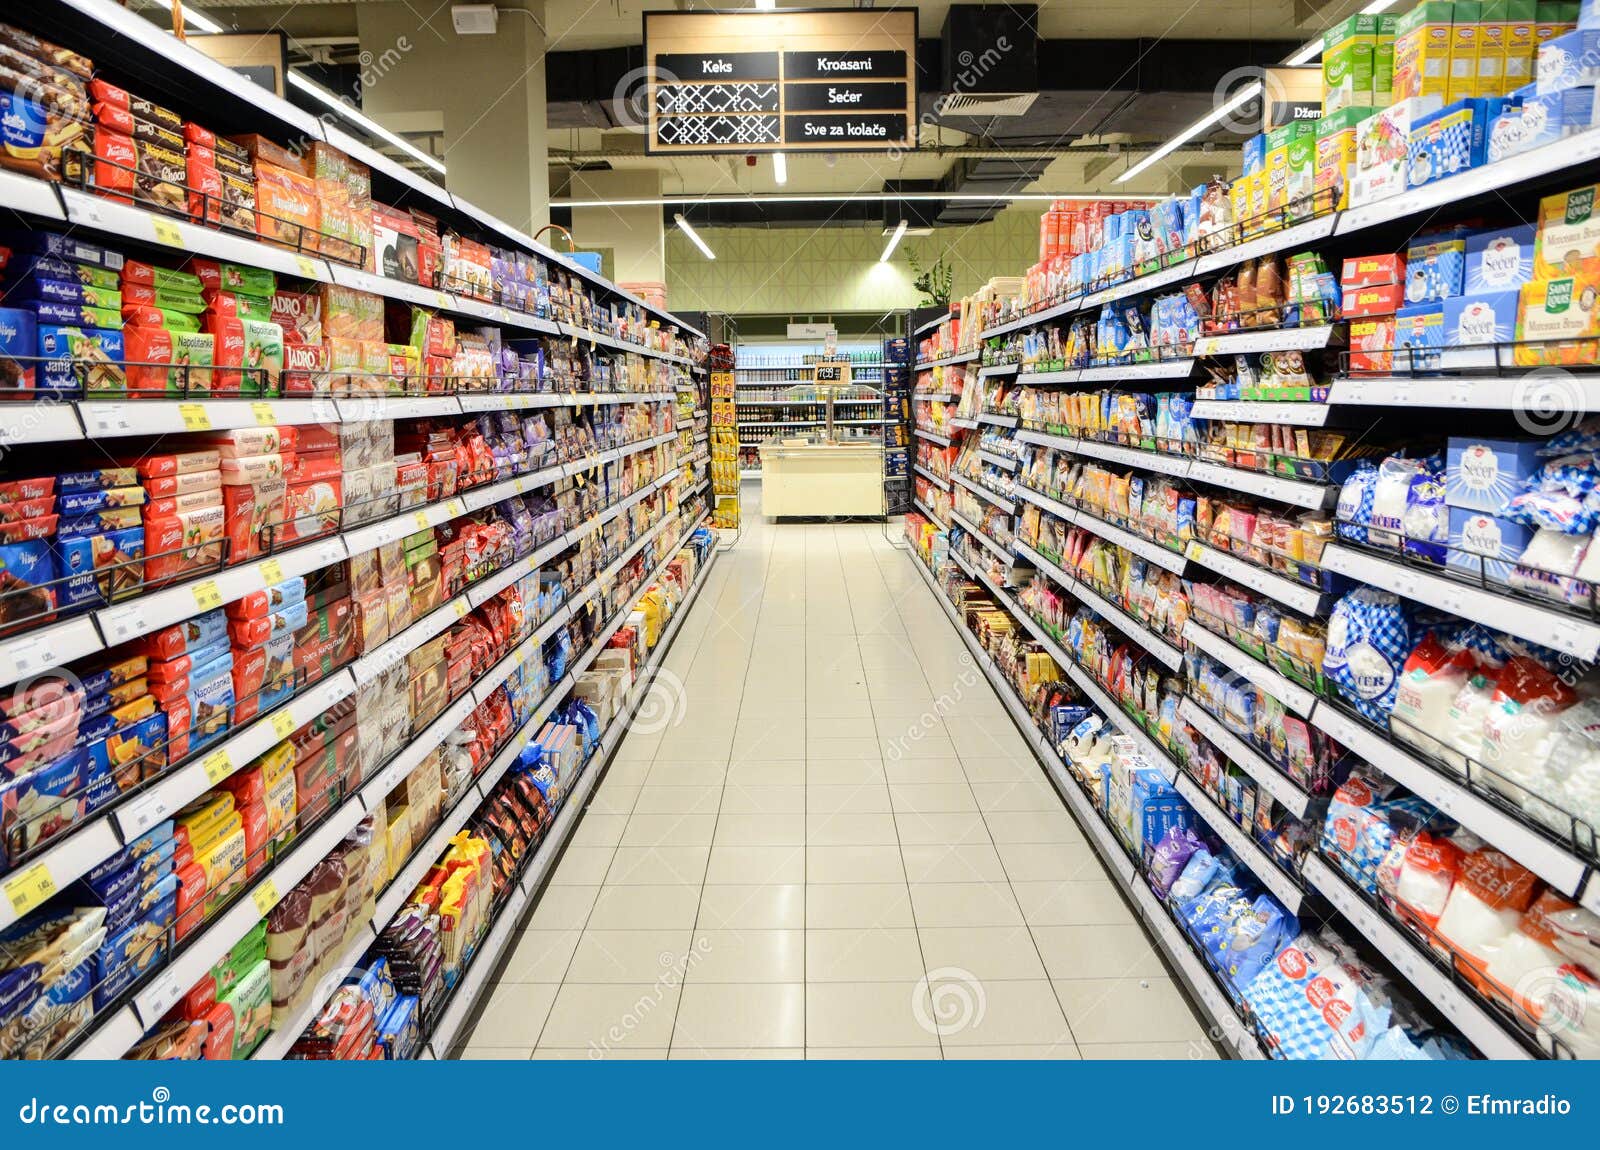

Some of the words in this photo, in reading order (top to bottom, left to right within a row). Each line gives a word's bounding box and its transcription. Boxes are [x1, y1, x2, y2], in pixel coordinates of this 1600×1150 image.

[702, 60, 732, 74] Keks
[817, 57, 872, 71] Kroasani
[828, 88, 862, 104] Šećer
[804, 123, 827, 136] Sve
[830, 125, 844, 136] za
[847, 122, 887, 137] kolače
[1568, 191, 1593, 206] SAINT
[1566, 204, 1592, 220] LOUIS
[1548, 283, 1571, 296] SAINT
[1547, 294, 1570, 309] LOUIS
[287, 345, 316, 371] JADRO
